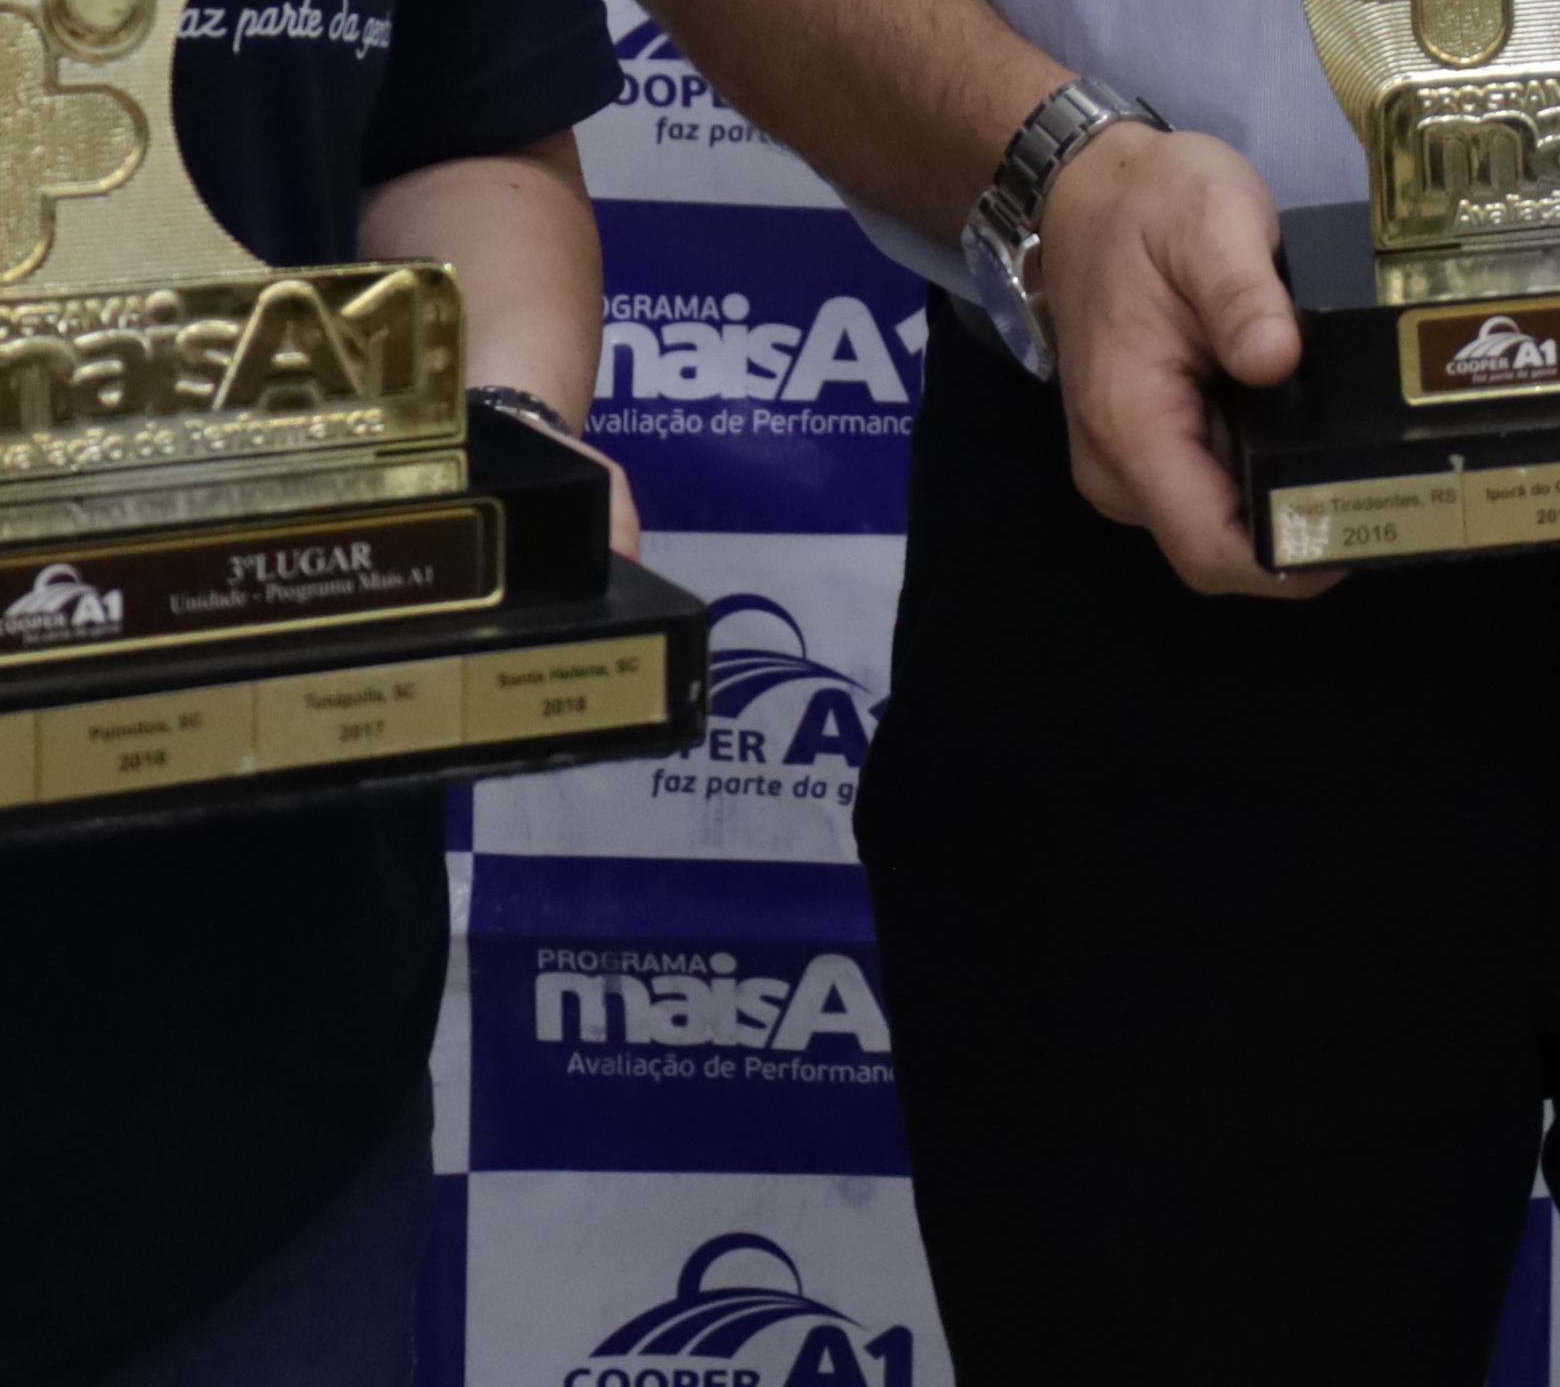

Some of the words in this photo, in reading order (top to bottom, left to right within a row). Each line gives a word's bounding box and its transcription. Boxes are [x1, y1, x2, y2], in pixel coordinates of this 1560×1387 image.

[176, 8, 227, 39] az
[1445, 353, 1510, 376] COOPER
[1513, 338, 1558, 370] A1
[1430, 487, 1457, 505] RS
[1531, 482, 1551, 497] do
[71, 589, 124, 628] A1
